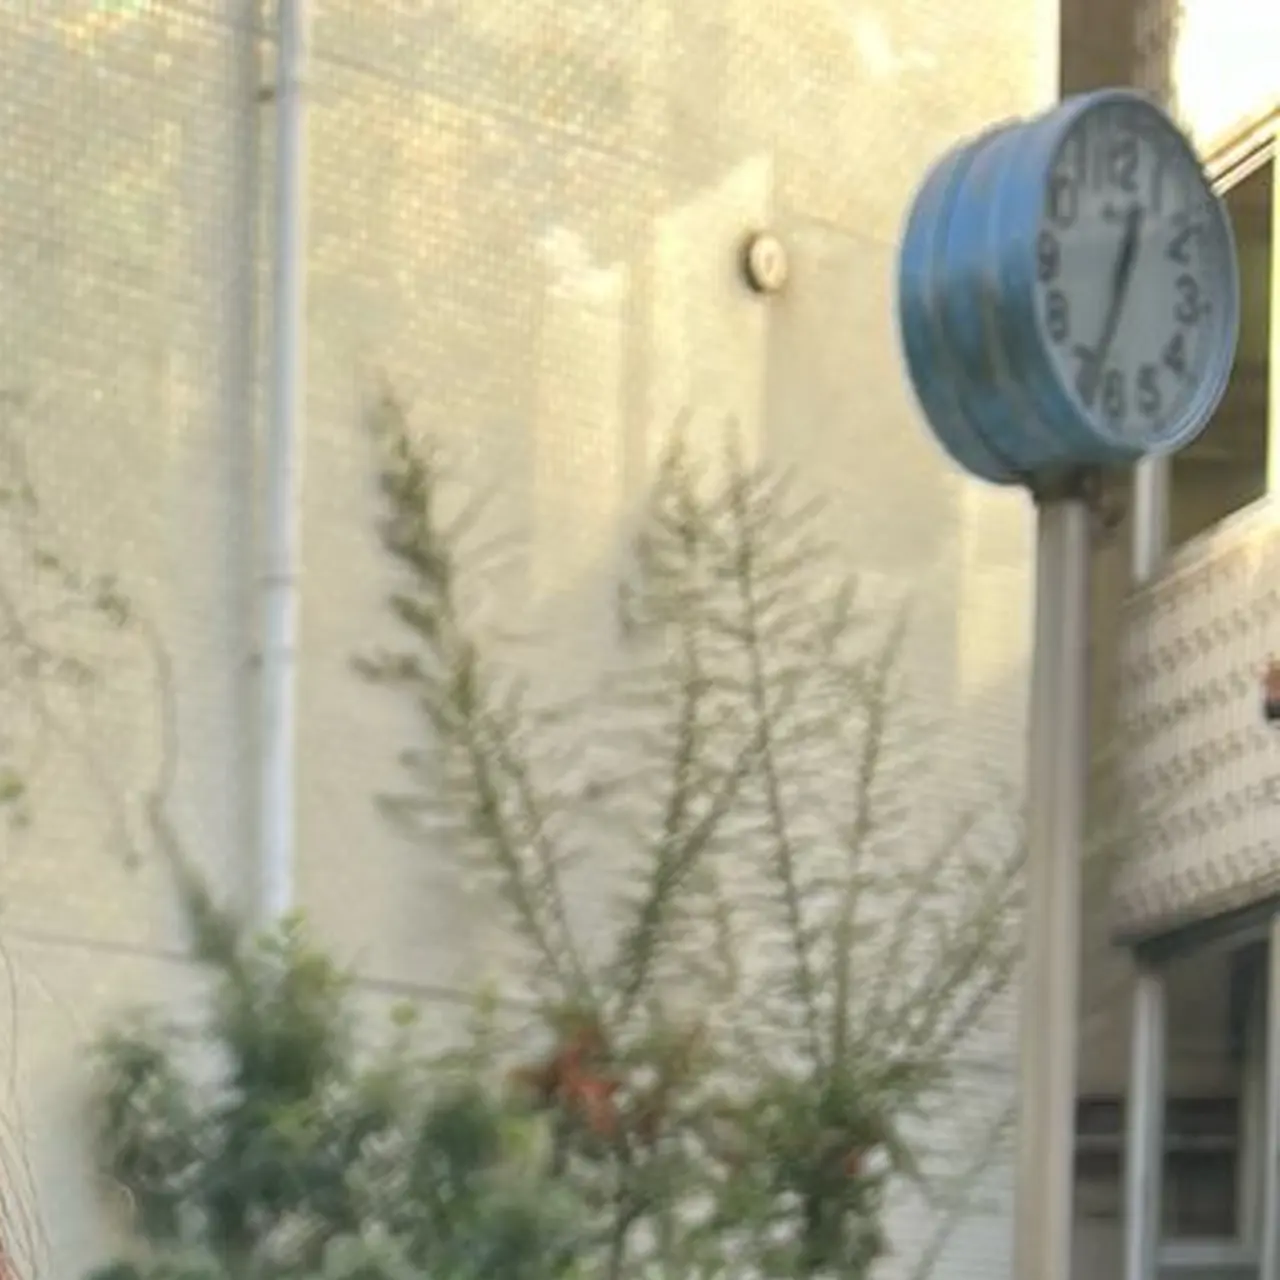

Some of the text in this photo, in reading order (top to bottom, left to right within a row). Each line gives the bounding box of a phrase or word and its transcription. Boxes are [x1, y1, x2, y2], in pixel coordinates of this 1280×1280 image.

[1037, 230, 1061, 281] 9
[1174, 273, 1198, 326] 3
[1102, 367, 1123, 418] 6
[1137, 364, 1160, 415] 5
